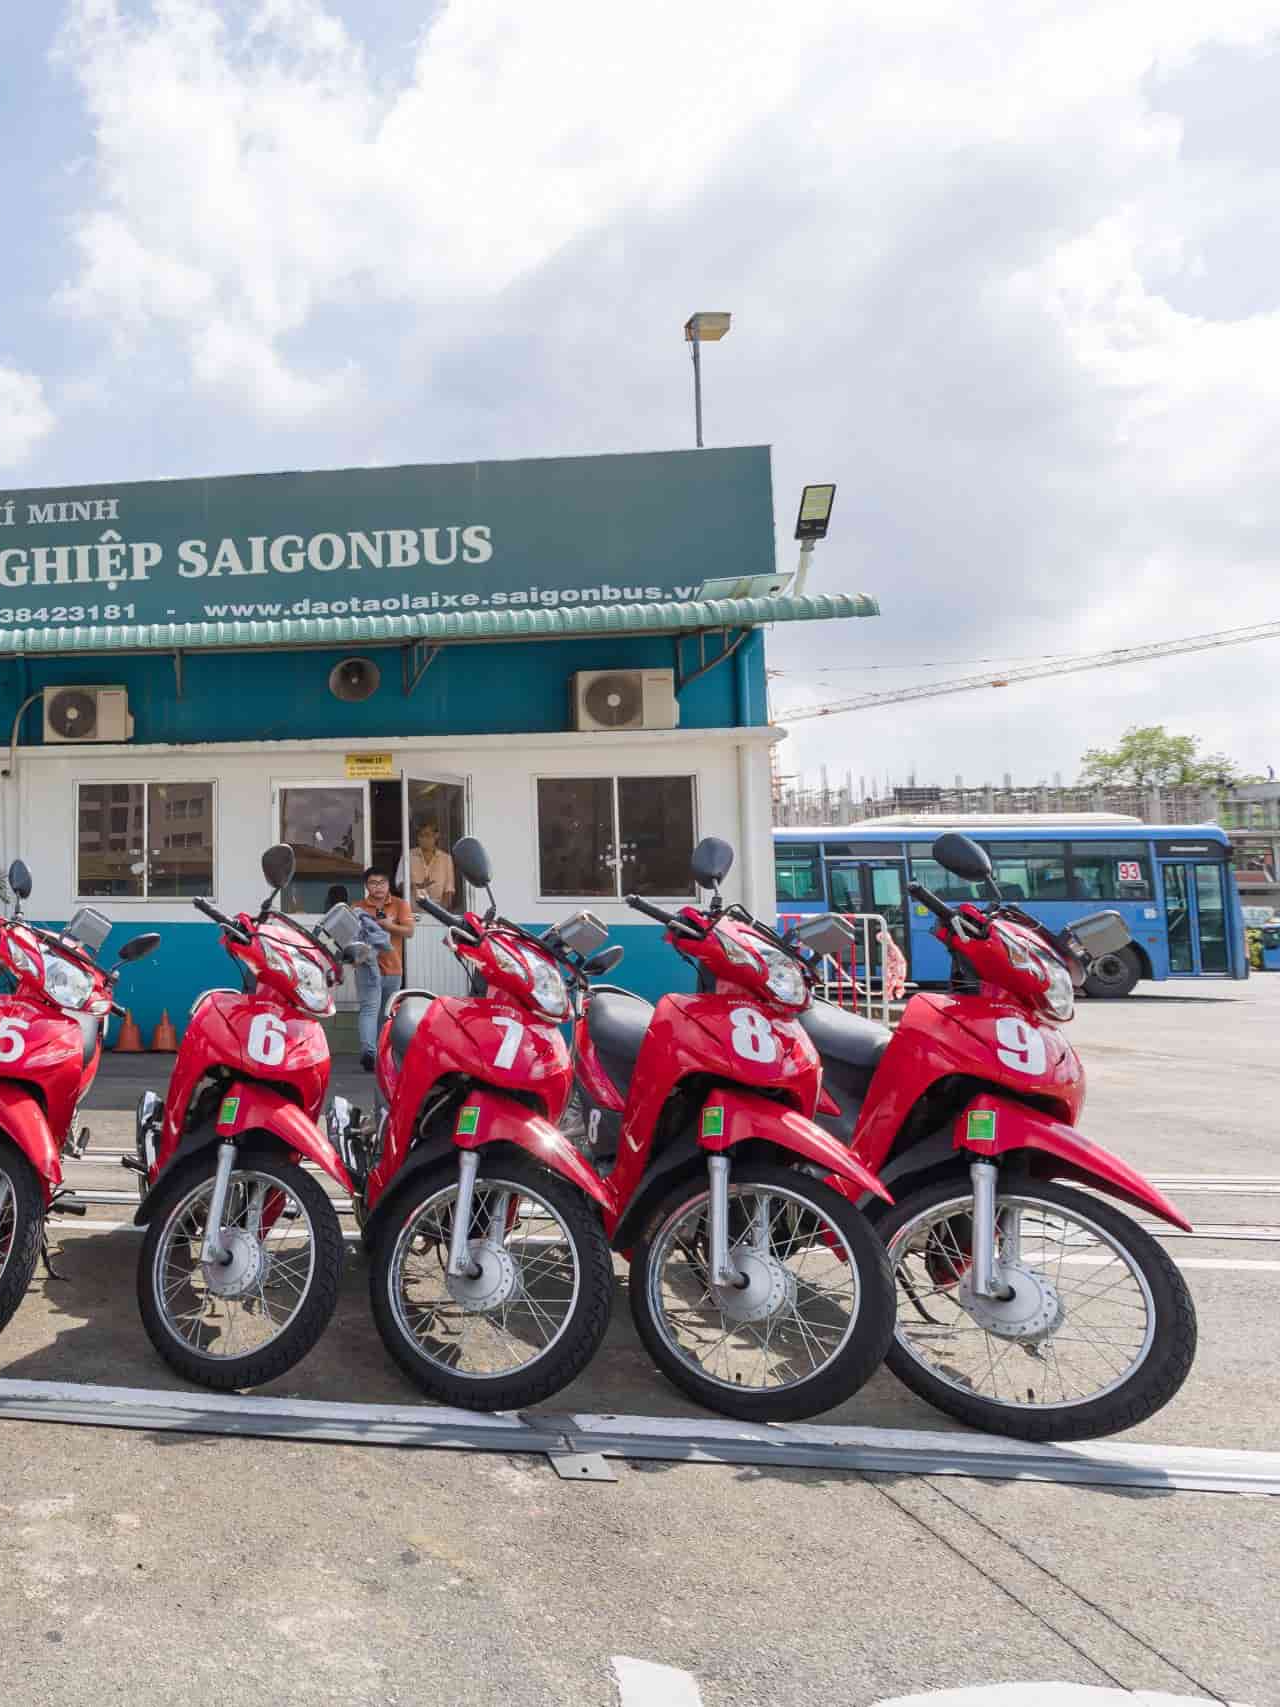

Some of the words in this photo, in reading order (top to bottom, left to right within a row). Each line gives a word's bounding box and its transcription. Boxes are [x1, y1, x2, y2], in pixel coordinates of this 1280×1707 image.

[27, 498, 120, 525] MINH
[177, 525, 494, 578] SAIGONBUS
[1119, 863, 1139, 879] 93
[248, 1012, 287, 1066] 6
[492, 1016, 523, 1070] 7
[729, 1008, 777, 1063] 8
[996, 1017, 1047, 1075] 9
[588, 1108, 601, 1144] 8
